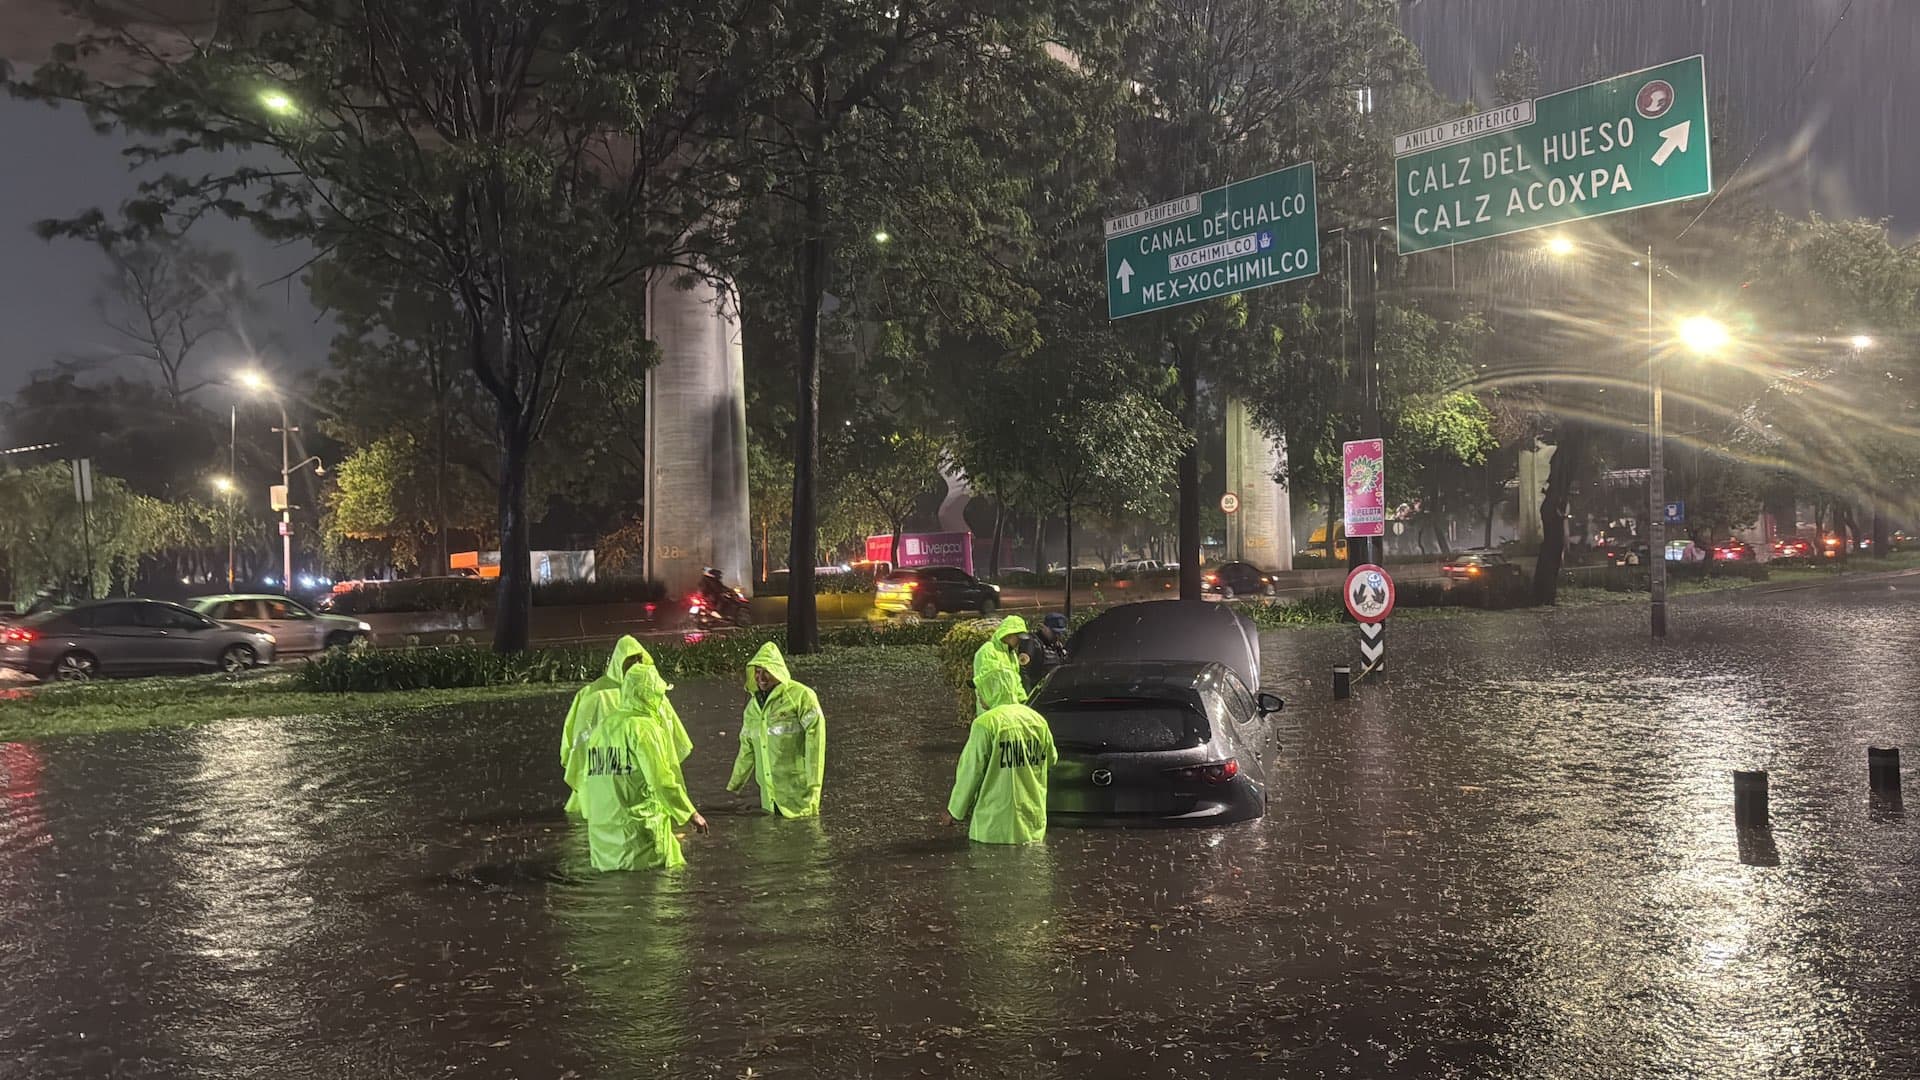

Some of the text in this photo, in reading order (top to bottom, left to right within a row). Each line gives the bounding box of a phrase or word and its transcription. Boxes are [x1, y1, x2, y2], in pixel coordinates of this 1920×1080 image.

[1405, 107, 1520, 149] ANILLO PERIFERICO
[1408, 117, 1634, 197] CALZ DEL HUESO
[1112, 200, 1190, 232] ANILLO PERIFERICO
[1414, 164, 1632, 235] CALZ ACOXPA
[1140, 193, 1305, 255] CANAL DE CHALCO
[1174, 238, 1251, 268] XOCHIMILCO
[1142, 248, 1308, 304] MEX-XOCHIMILCO
[921, 541, 962, 556] Liverpool
[999, 740, 1025, 769] ZONA
